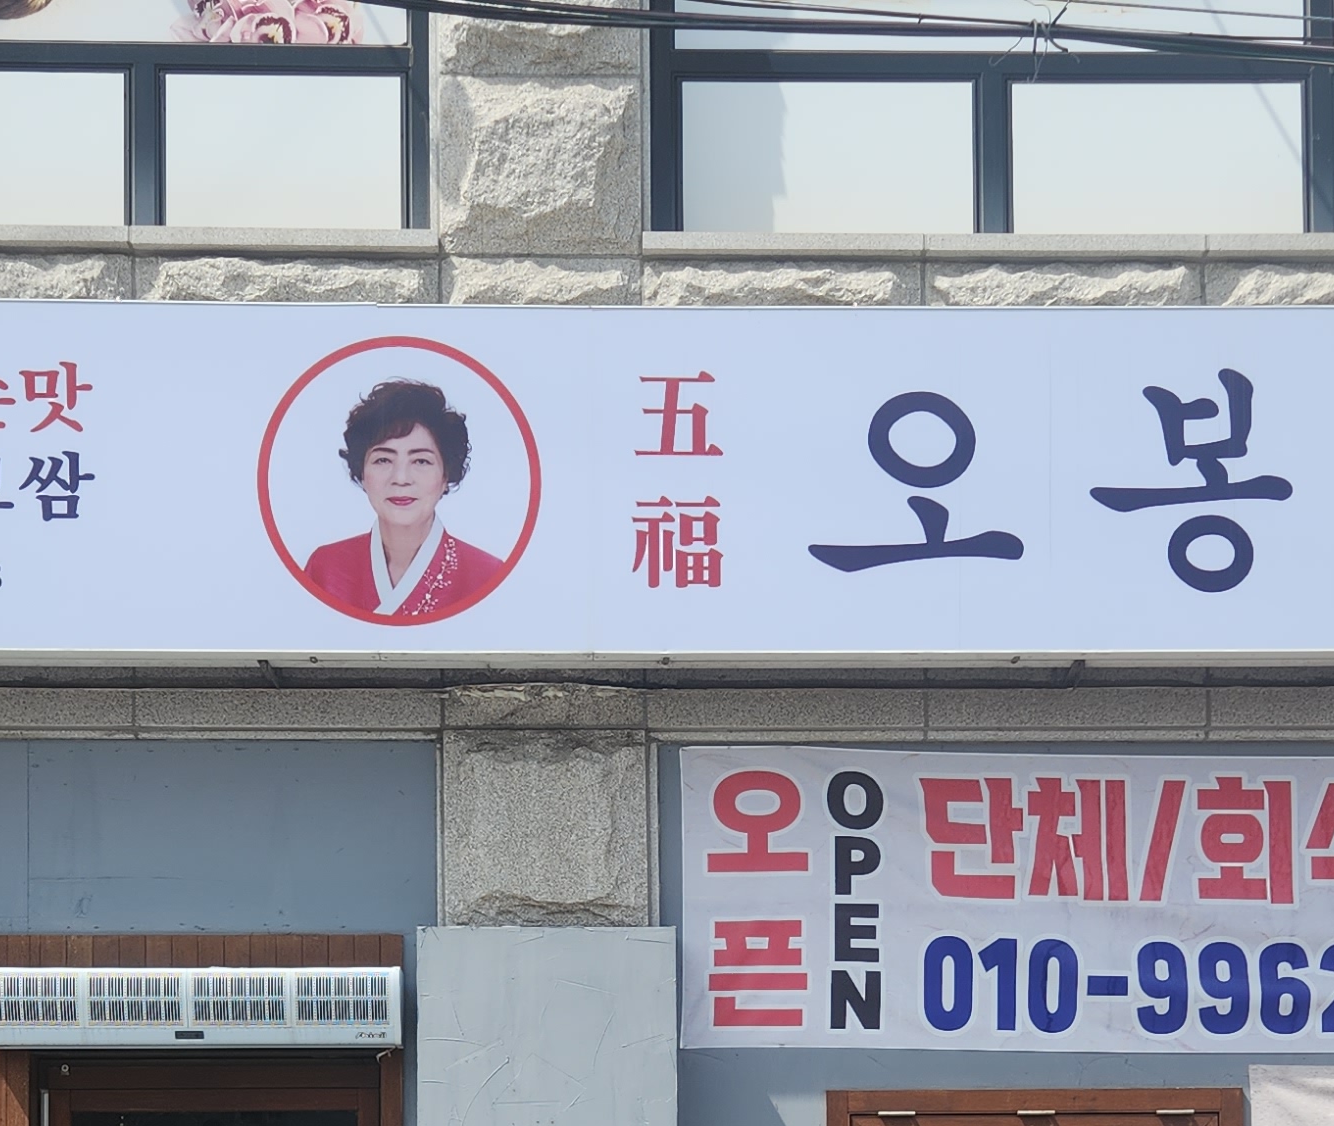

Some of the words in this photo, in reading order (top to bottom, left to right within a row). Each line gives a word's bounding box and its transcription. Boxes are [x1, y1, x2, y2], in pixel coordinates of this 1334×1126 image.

[631, 371, 724, 590] 五福
[707, 770, 809, 1027] 오픈
[826, 771, 884, 1030] OPEN
